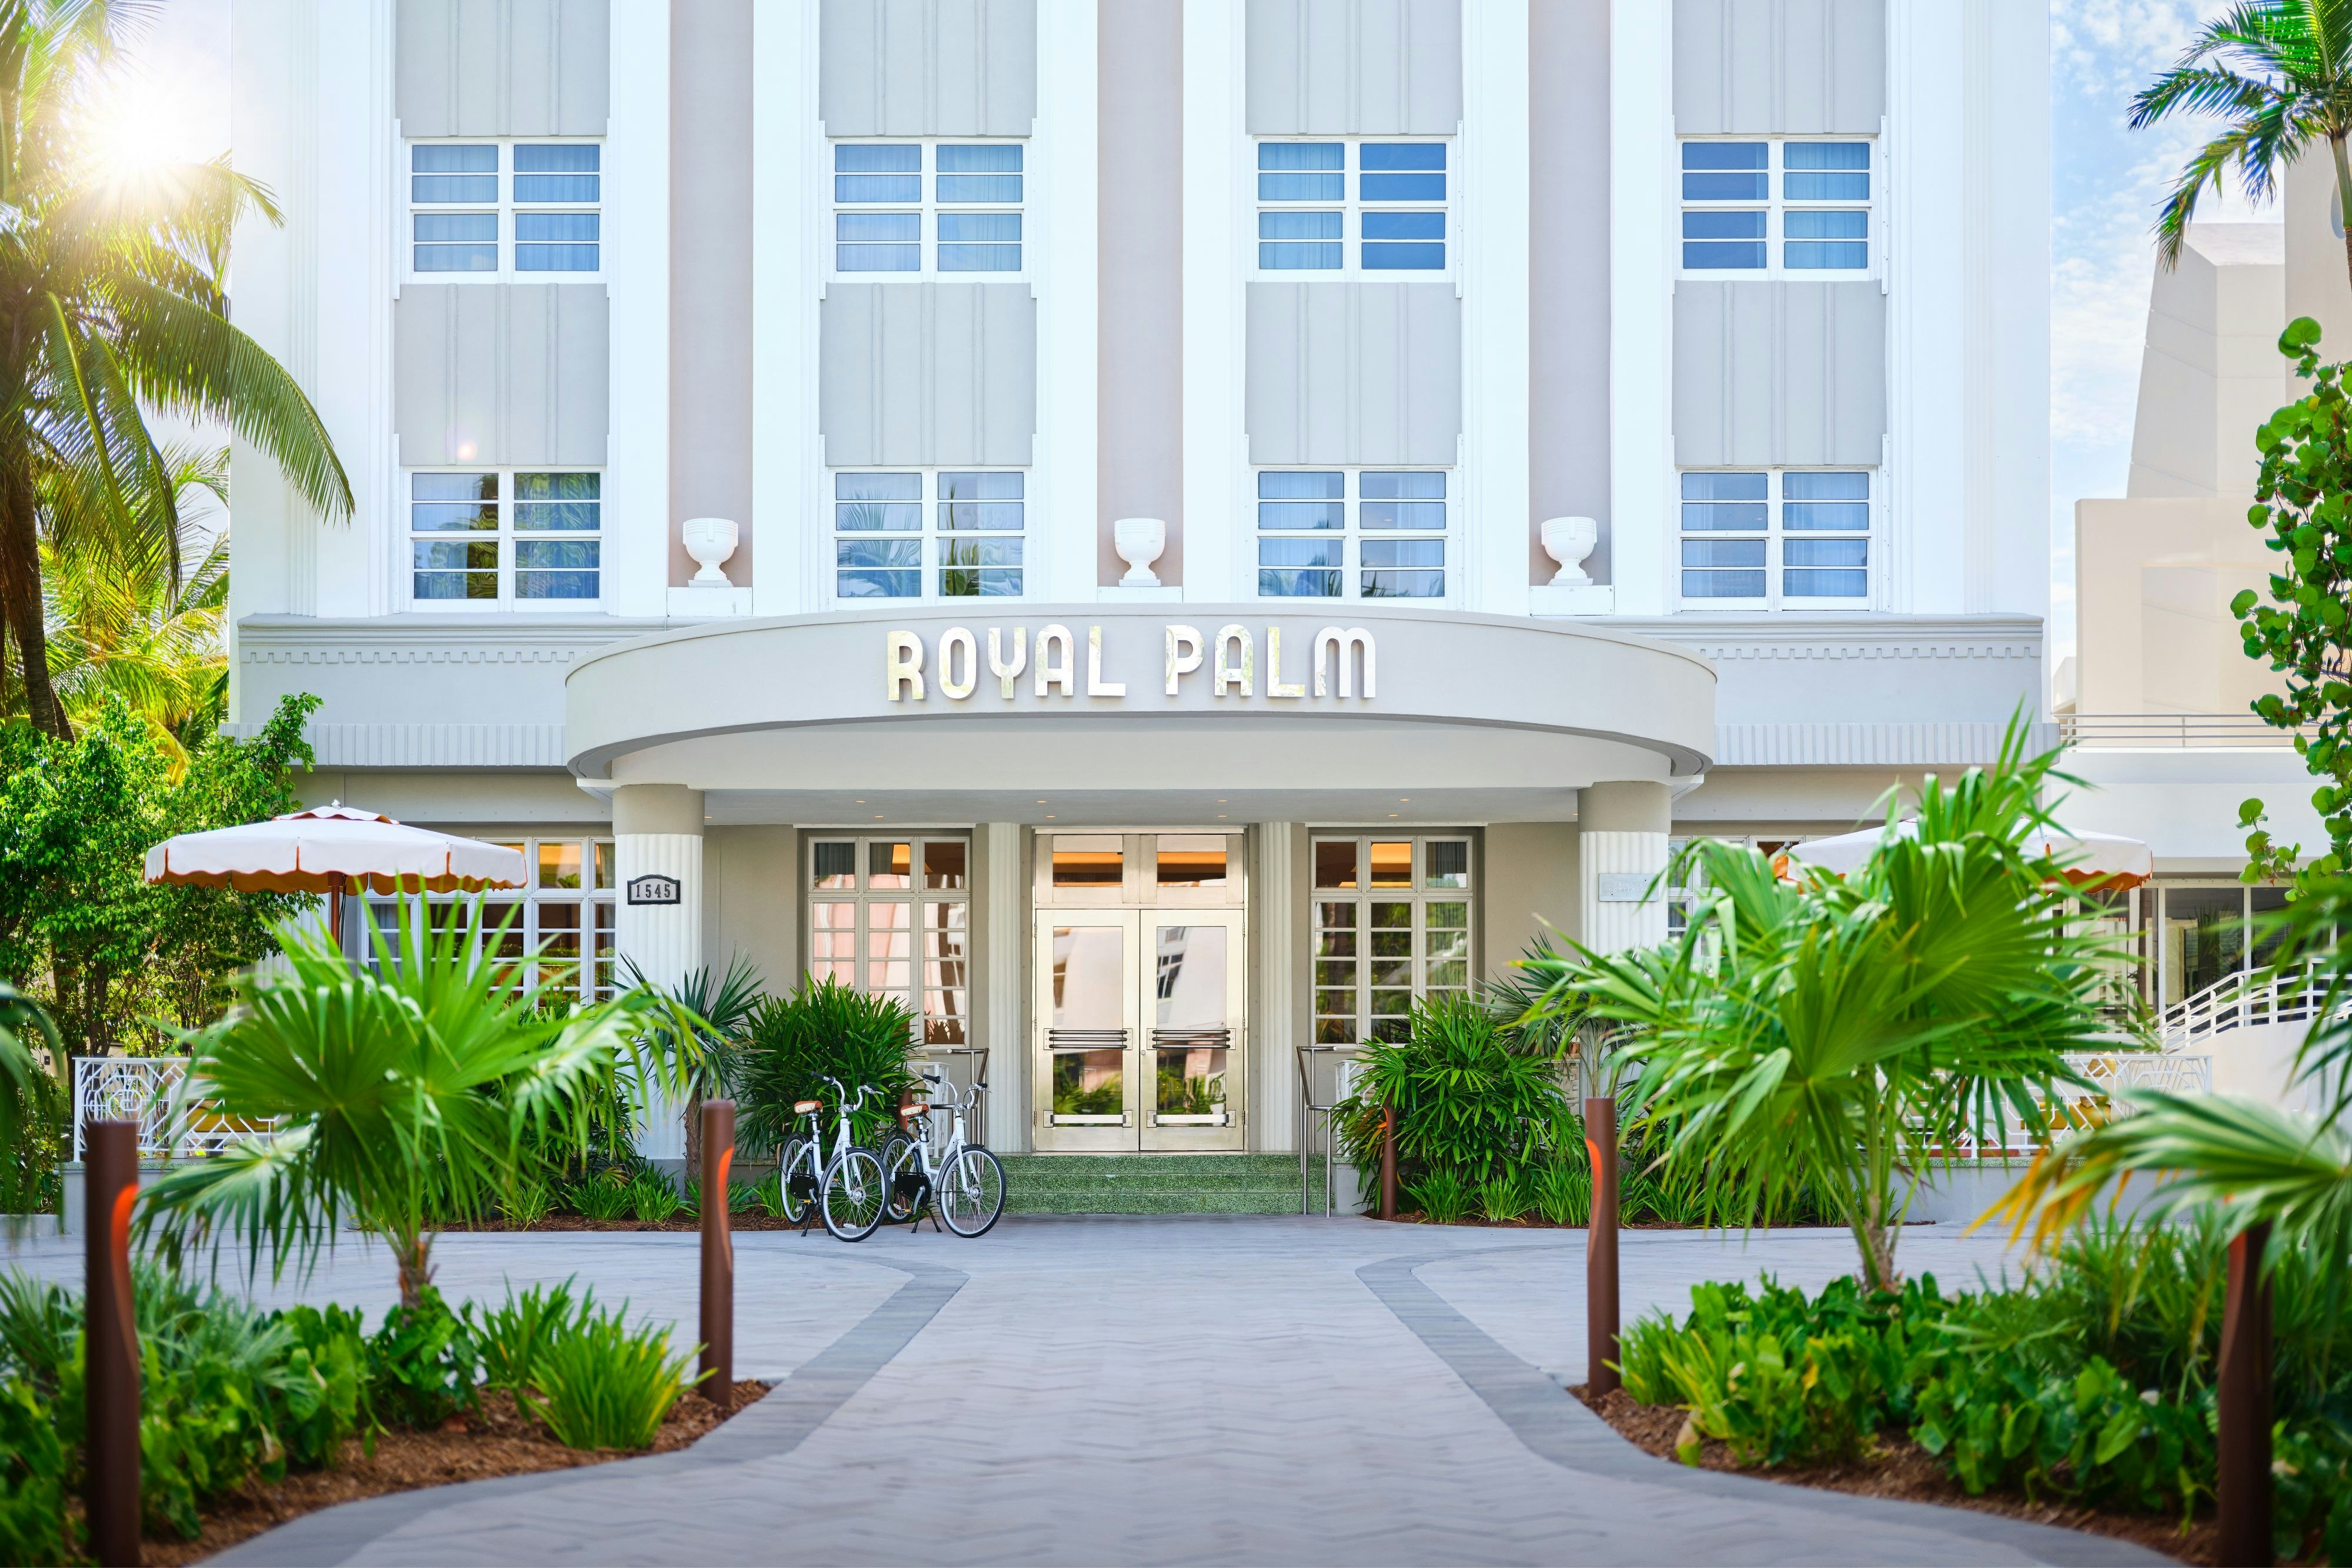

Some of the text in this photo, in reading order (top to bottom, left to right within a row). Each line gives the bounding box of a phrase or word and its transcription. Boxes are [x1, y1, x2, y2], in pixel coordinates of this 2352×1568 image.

[887, 624, 1377, 701] ROYAL PALM
[636, 884, 670, 898] 1545
